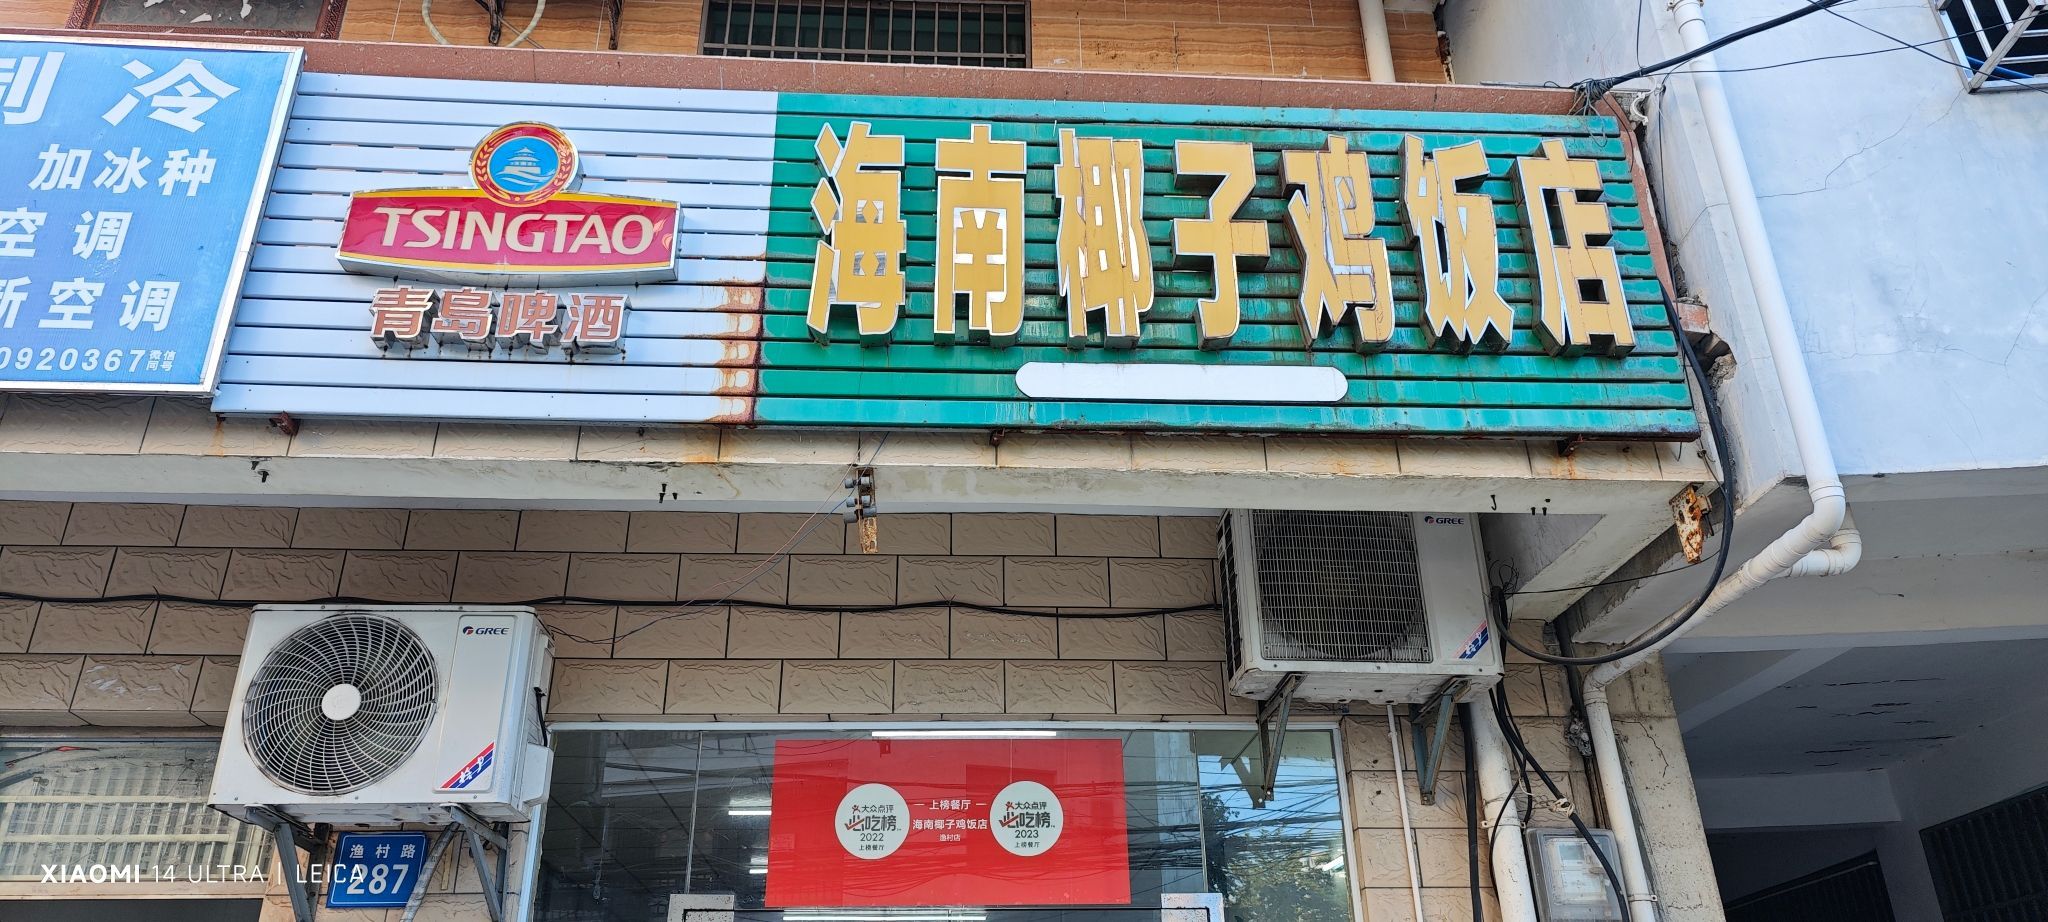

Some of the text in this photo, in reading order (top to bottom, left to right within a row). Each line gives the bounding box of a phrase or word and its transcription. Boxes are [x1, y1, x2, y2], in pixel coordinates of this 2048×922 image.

[28, 143, 217, 197] 加冰种
[0, 206, 133, 261] 空调
[373, 206, 656, 255] TSINGTAO
[806, 121, 1634, 352] 海南椰子鸡饭店
[370, 286, 629, 342] 青岛啤酒
[1436, 516, 1464, 525] GREE
[475, 627, 509, 636] GREE
[861, 804, 894, 814] 大众点评
[929, 799, 972, 811] 上榜餐厅
[1015, 800, 1048, 811] 大众点评
[845, 814, 898, 832] 必吃榜
[912, 818, 988, 831] 海南椰子鸡饭店
[999, 811, 1051, 829] 必吃榜
[859, 832, 885, 843] 2022
[1014, 829, 1040, 840] 2023
[349, 843, 416, 859] 渔村路
[1014, 840, 1041, 849] 上榜餐厅
[346, 863, 409, 895] 287
